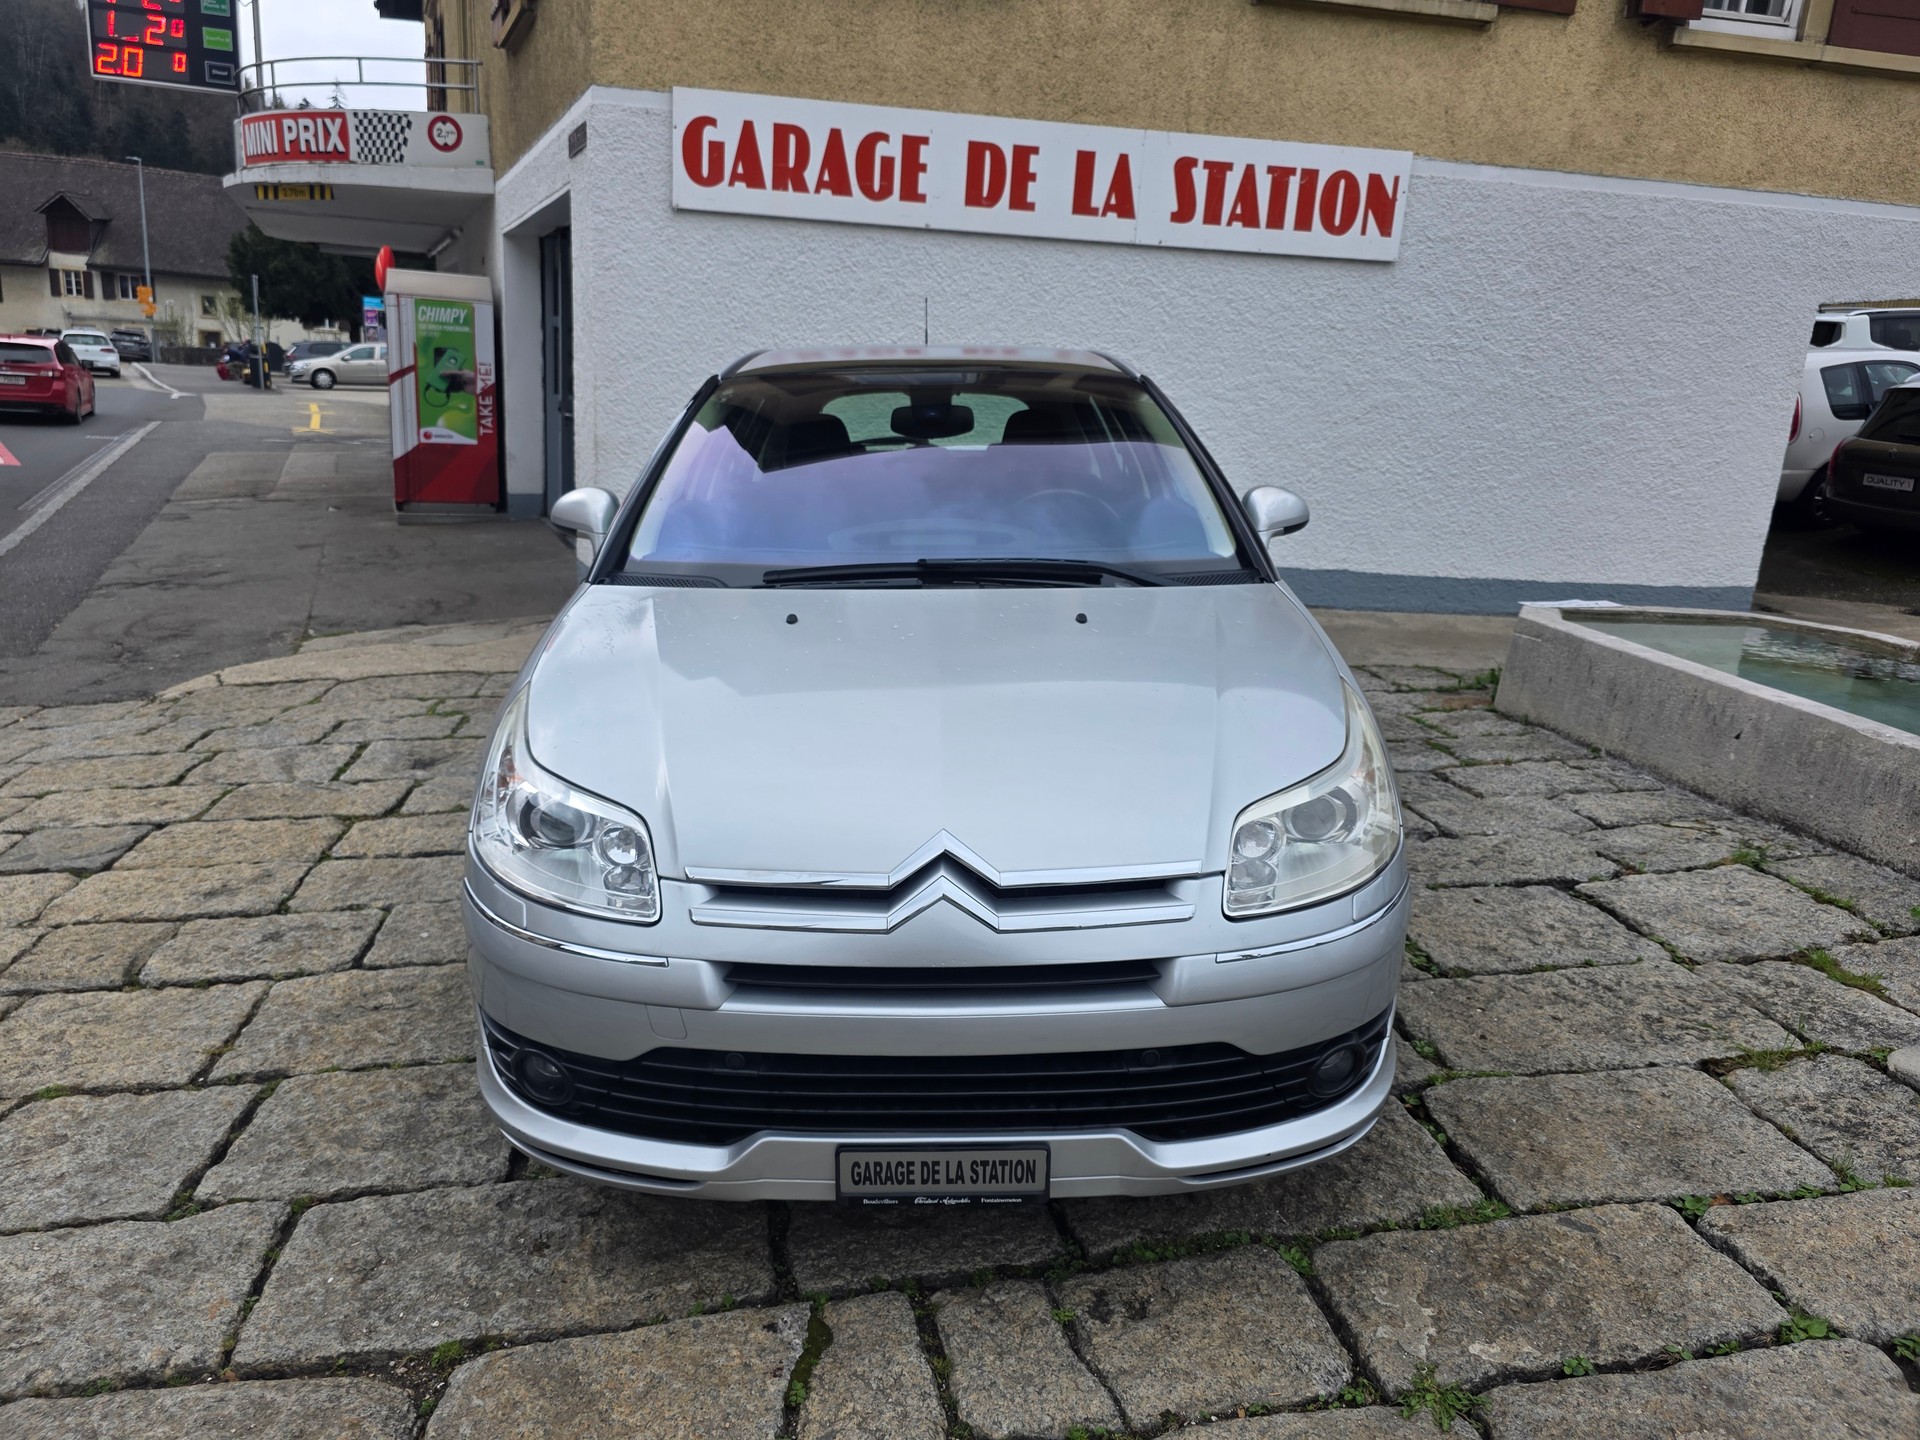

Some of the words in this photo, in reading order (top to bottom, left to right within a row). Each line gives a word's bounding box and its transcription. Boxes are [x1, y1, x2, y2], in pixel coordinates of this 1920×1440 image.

[245, 119, 279, 157] MINI
[282, 117, 347, 154] PRIX
[682, 114, 930, 204] GARAGE
[964, 139, 1040, 213] DE
[1071, 149, 1137, 220] LA
[1169, 154, 1401, 238] STATION
[418, 305, 467, 324] CHIMPY
[478, 362, 492, 394] ME!
[478, 394, 494, 437] TAKE
[851, 1160, 916, 1186] GARAGE
[920, 1160, 941, 1186] DE
[945, 1160, 966, 1185] LA
[969, 1159, 1037, 1185] STATION
